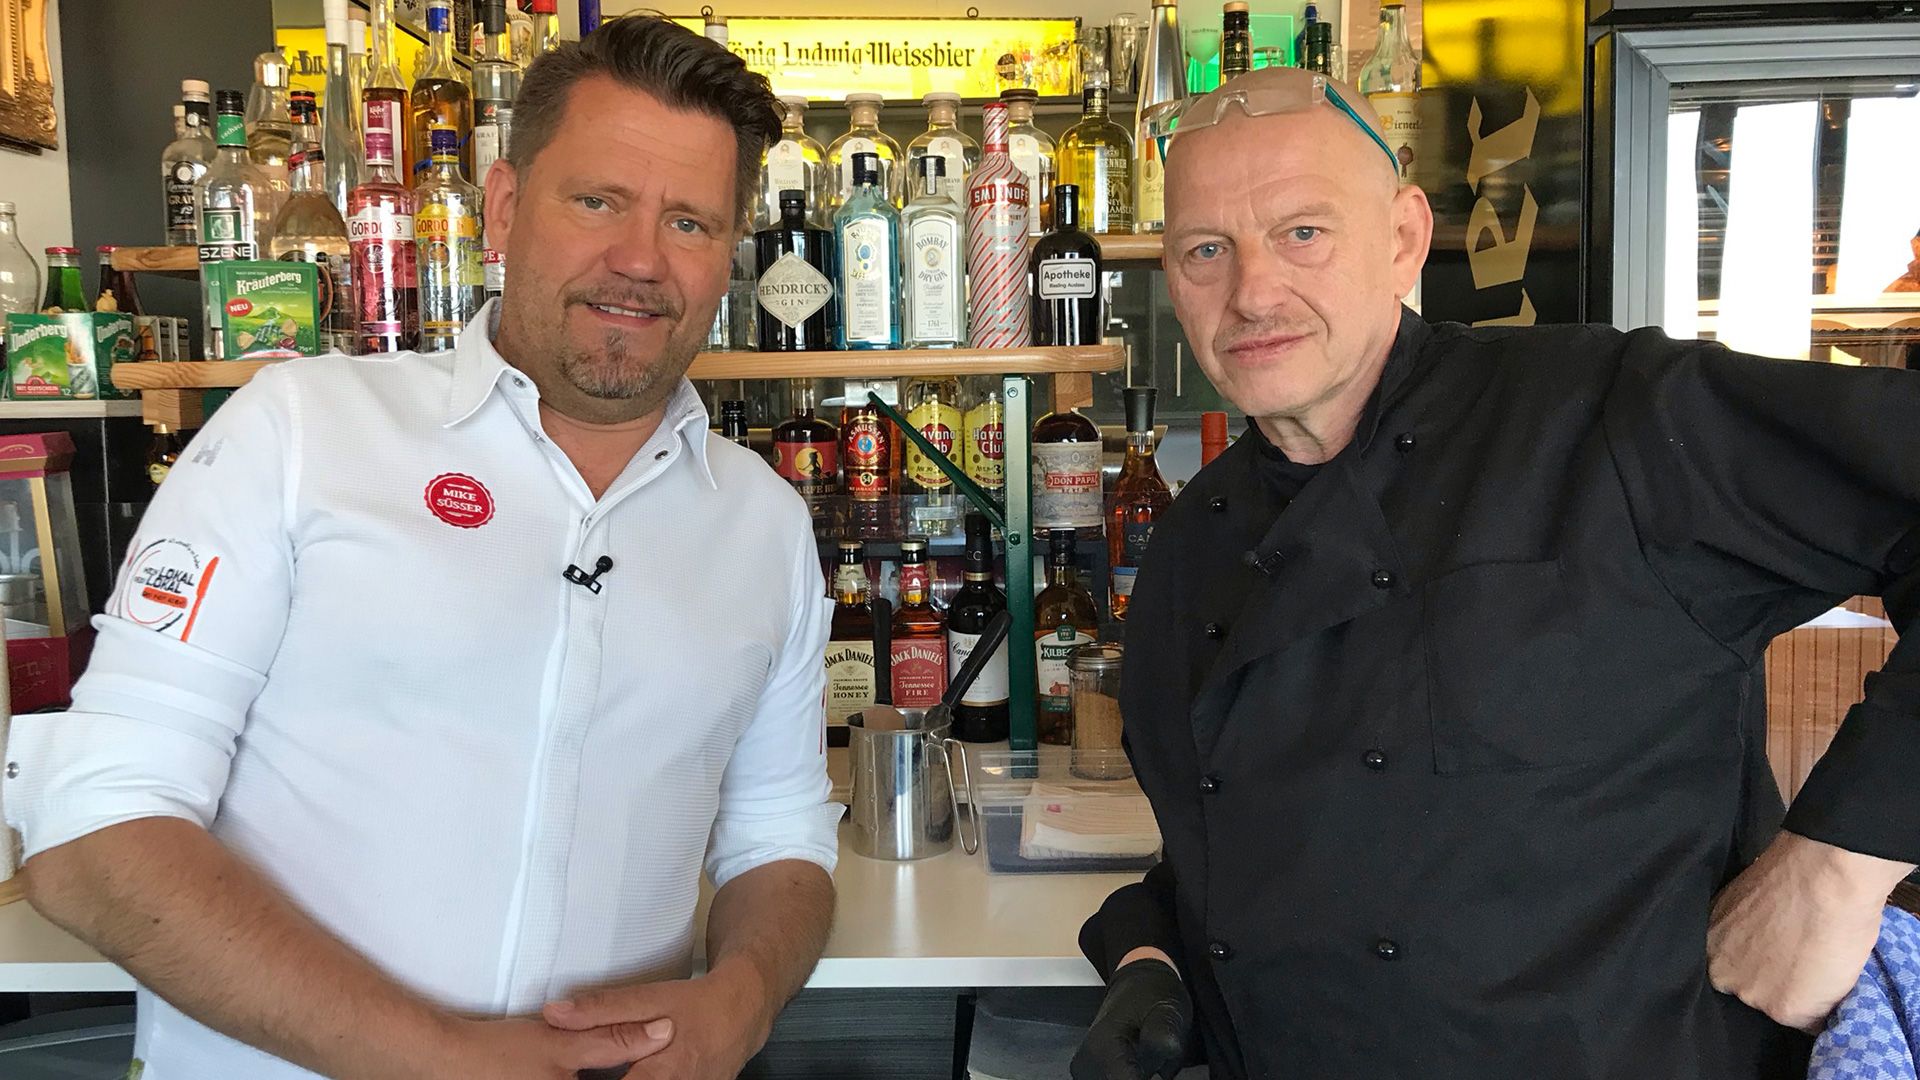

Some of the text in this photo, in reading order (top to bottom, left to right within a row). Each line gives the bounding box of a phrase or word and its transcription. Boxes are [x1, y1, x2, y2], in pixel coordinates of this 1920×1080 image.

[728, 40, 776, 76] önig
[351, 220, 402, 236] GORD'S
[915, 236, 949, 251] BOMBAY
[200, 247, 253, 259] SZENE
[1043, 269, 1091, 280] Apotheke
[236, 271, 302, 295] Kräuterberg
[759, 283, 829, 295] HENDRICK'S
[229, 304, 249, 312] NEU
[11, 323, 68, 352] Underberg
[848, 424, 886, 444] ASMUSSEN
[916, 428, 956, 440] avana
[973, 427, 1003, 441] Hava
[1054, 477, 1096, 485] DON PAPA
[443, 488, 477, 502] MIKE
[436, 498, 485, 514] SÜSSER
[146, 574, 182, 594] LOKAL
[159, 566, 194, 587] LOKAL
[824, 648, 876, 669] JACK DANIEL
[890, 649, 911, 667] JACK
[911, 646, 943, 666] DANIEL'S
